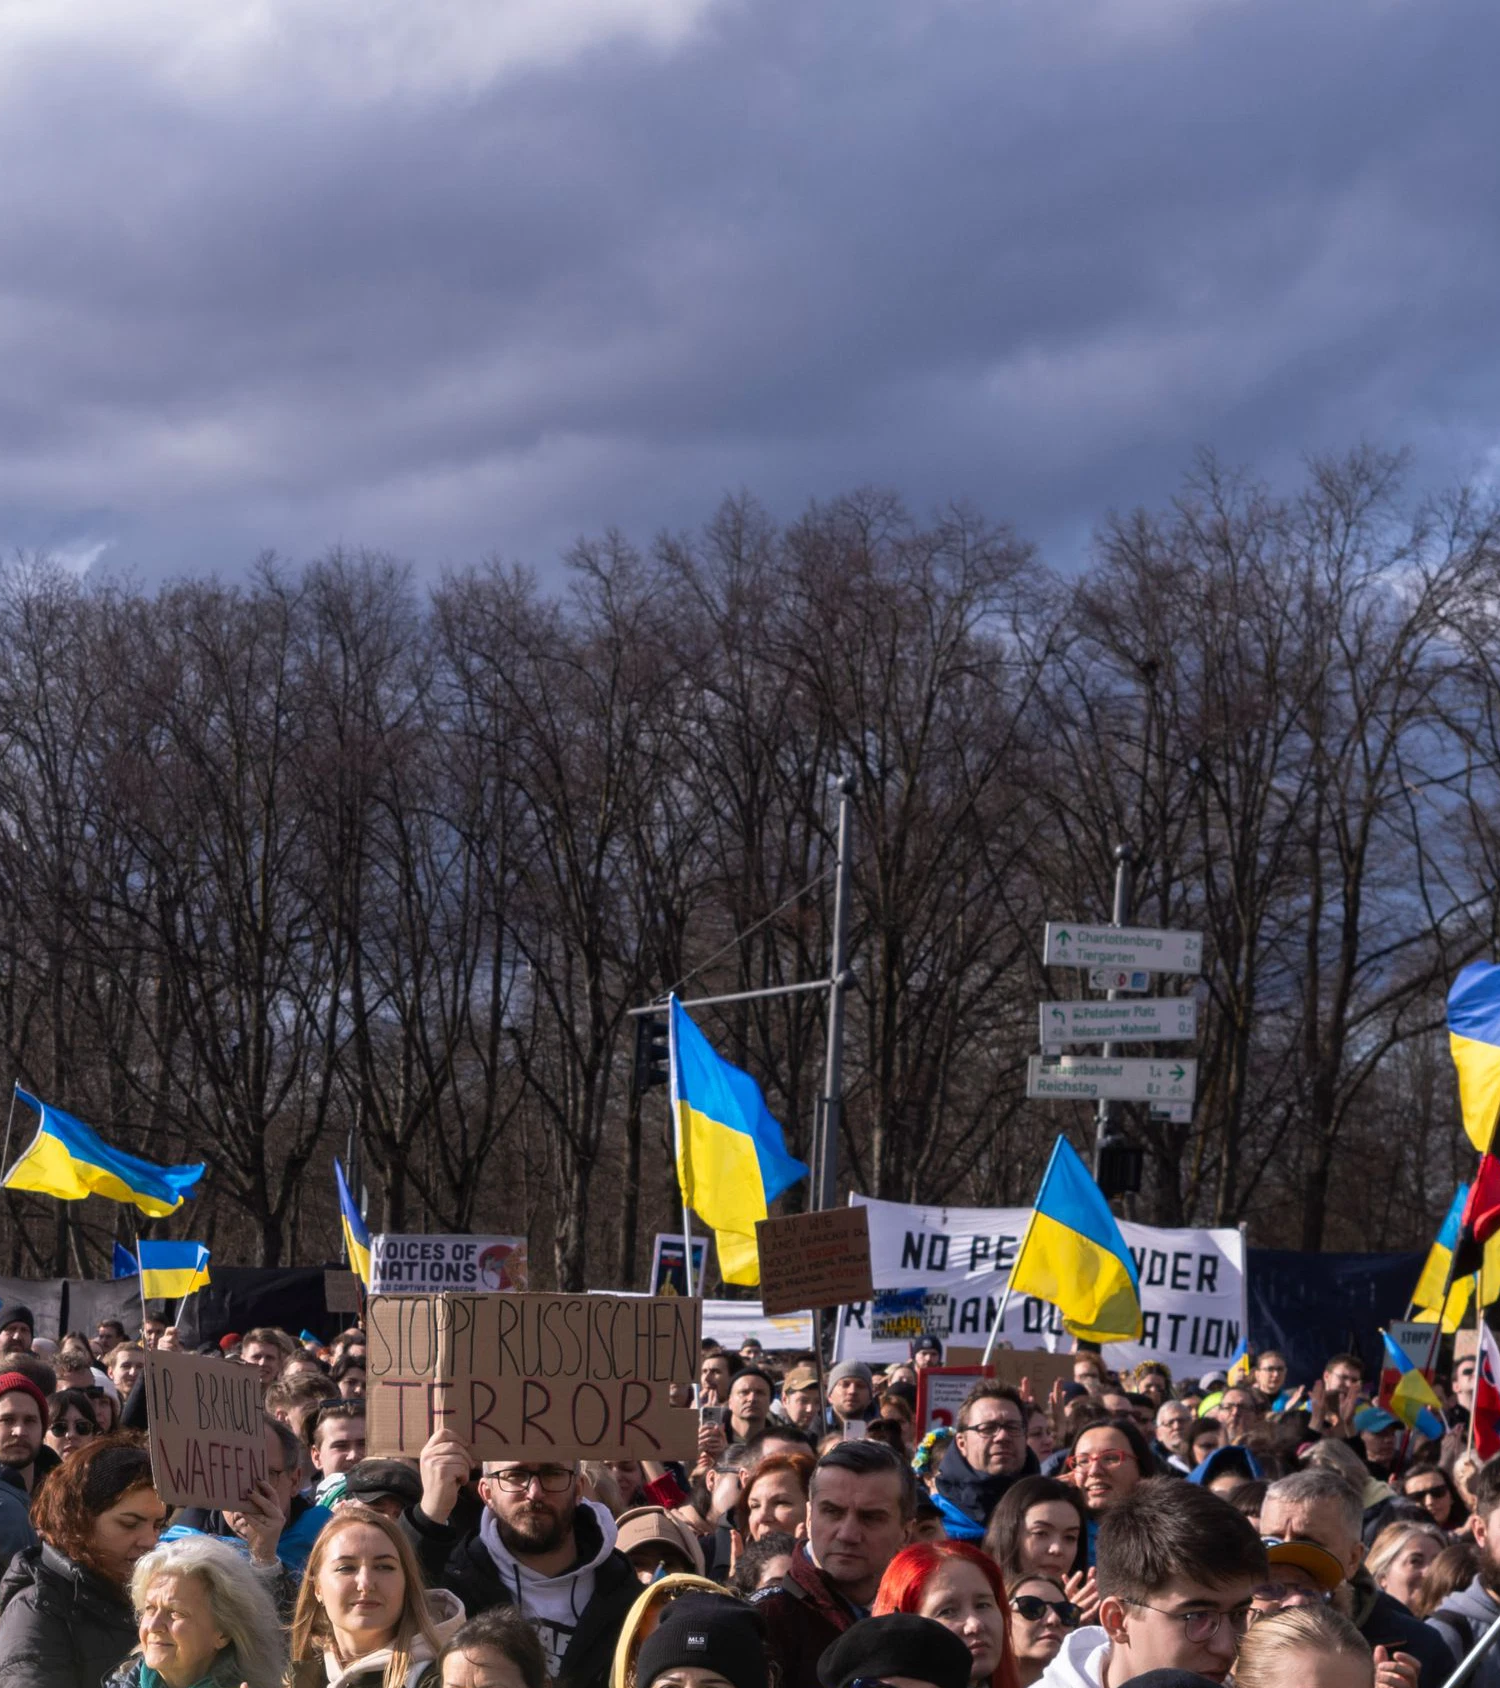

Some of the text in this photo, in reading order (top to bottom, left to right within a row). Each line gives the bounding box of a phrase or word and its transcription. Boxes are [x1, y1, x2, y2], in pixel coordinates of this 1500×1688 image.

[1077, 931, 1163, 950] Charlottenburg
[1077, 947, 1136, 965] Tiergarten
[1084, 1007, 1131, 1019] Potsdamer
[1133, 1005, 1156, 1017] Platz
[1072, 1023, 1161, 1037] Holocaust-Mahnmal
[1055, 1064, 1123, 1078] Hauptbahnhof
[1037, 1080, 1098, 1096] Reichstag
[809, 1214, 834, 1231] WIE
[374, 1241, 478, 1261] VOICES OF
[373, 1260, 478, 1283] NATIONS
[901, 1231, 951, 1272] NO
[1130, 1246, 1220, 1294] NDER
[393, 1284, 427, 1292] CAPTIVE
[370, 1294, 698, 1382] STOPPT RUSSISCHEN
[381, 1379, 662, 1452] TERROR
[159, 1437, 267, 1502] WAFFEN
[688, 1636, 705, 1644] MLS
